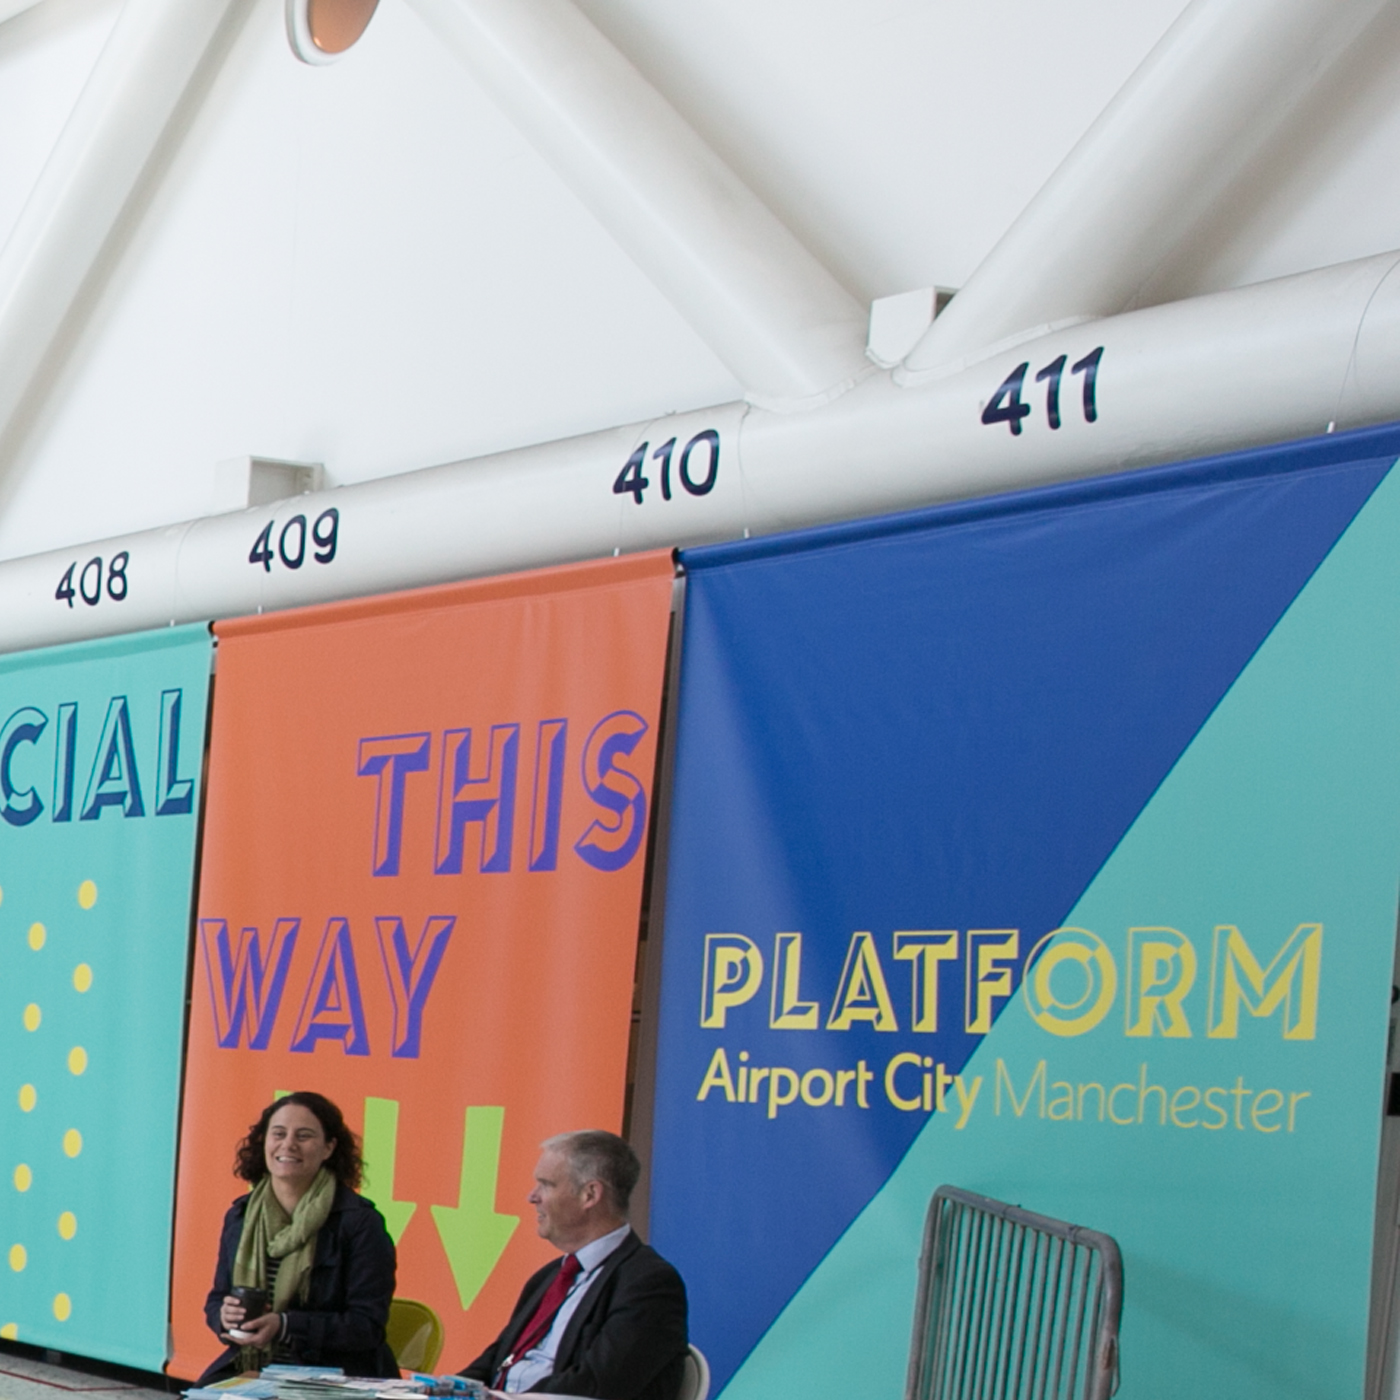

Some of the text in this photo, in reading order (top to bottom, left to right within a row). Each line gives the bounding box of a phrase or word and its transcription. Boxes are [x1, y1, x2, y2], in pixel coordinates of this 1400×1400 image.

[981, 346, 1105, 437] 411
[613, 428, 721, 506] 410
[55, 551, 129, 608] 408
[249, 508, 340, 573] 409
[356, 709, 650, 877] THIS
[198, 914, 458, 1060] WAY
[700, 922, 1324, 1042] PLATFORM
[696, 1046, 1311, 1134] Airport City Manchester
